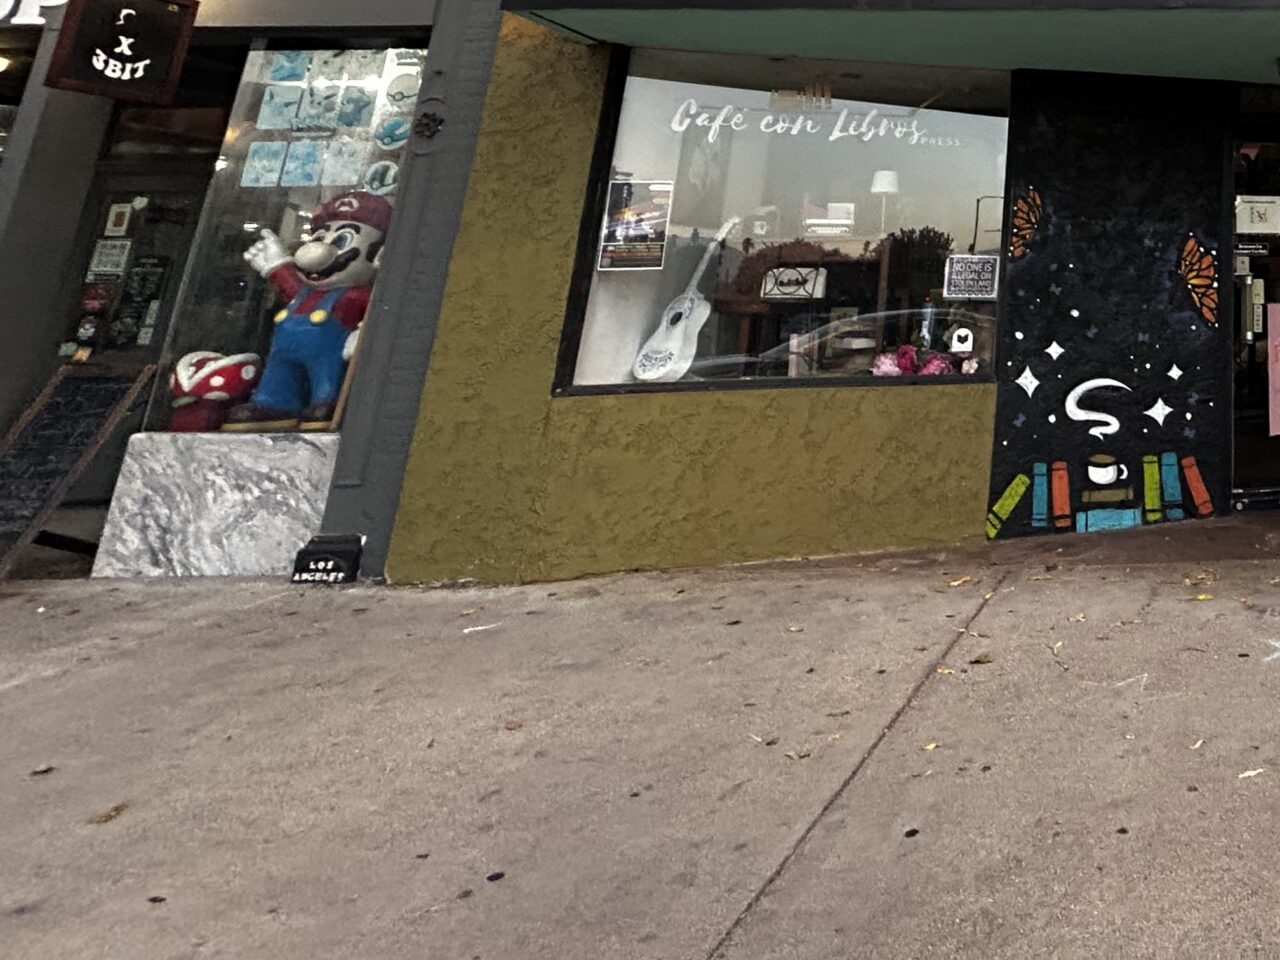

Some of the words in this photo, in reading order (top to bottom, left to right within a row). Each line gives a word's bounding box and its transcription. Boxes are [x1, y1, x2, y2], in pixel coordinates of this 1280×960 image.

[671, 98, 749, 143] Café
[759, 113, 821, 136] con
[828, 107, 927, 144] Libros
[920, 136, 960, 146] PRESS
[953, 263, 965, 271] NO
[966, 263, 983, 271] ONE
[984, 263, 992, 271] IS
[952, 272, 979, 280] ILLEGAL
[980, 272, 992, 280] ON
[309, 560, 334, 570] LOS
[292, 572, 345, 583] ANGELES
